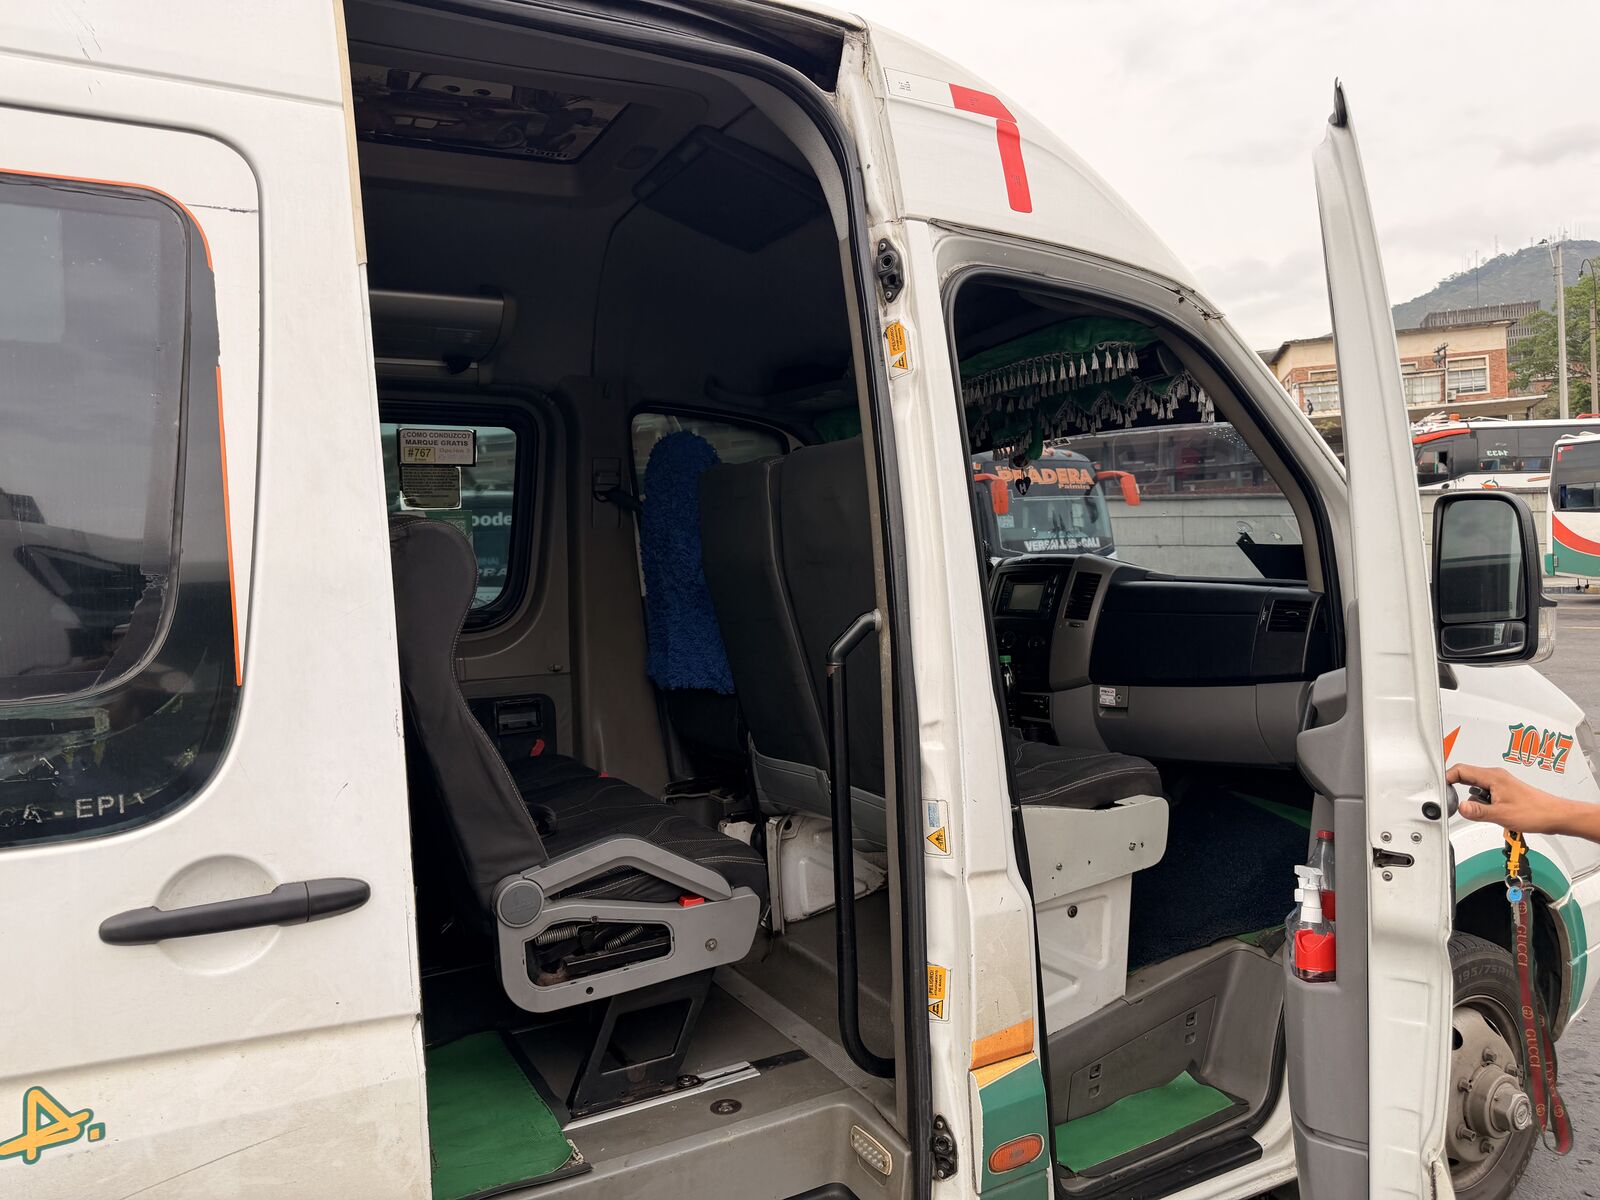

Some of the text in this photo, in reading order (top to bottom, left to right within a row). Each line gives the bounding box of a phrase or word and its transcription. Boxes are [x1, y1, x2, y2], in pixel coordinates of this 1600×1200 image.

[407, 448, 431, 458] #767
[1501, 722, 1574, 775] 1047
[1515, 924, 1529, 968] GUCCI
[1525, 1028, 1541, 1069] GUCCI
